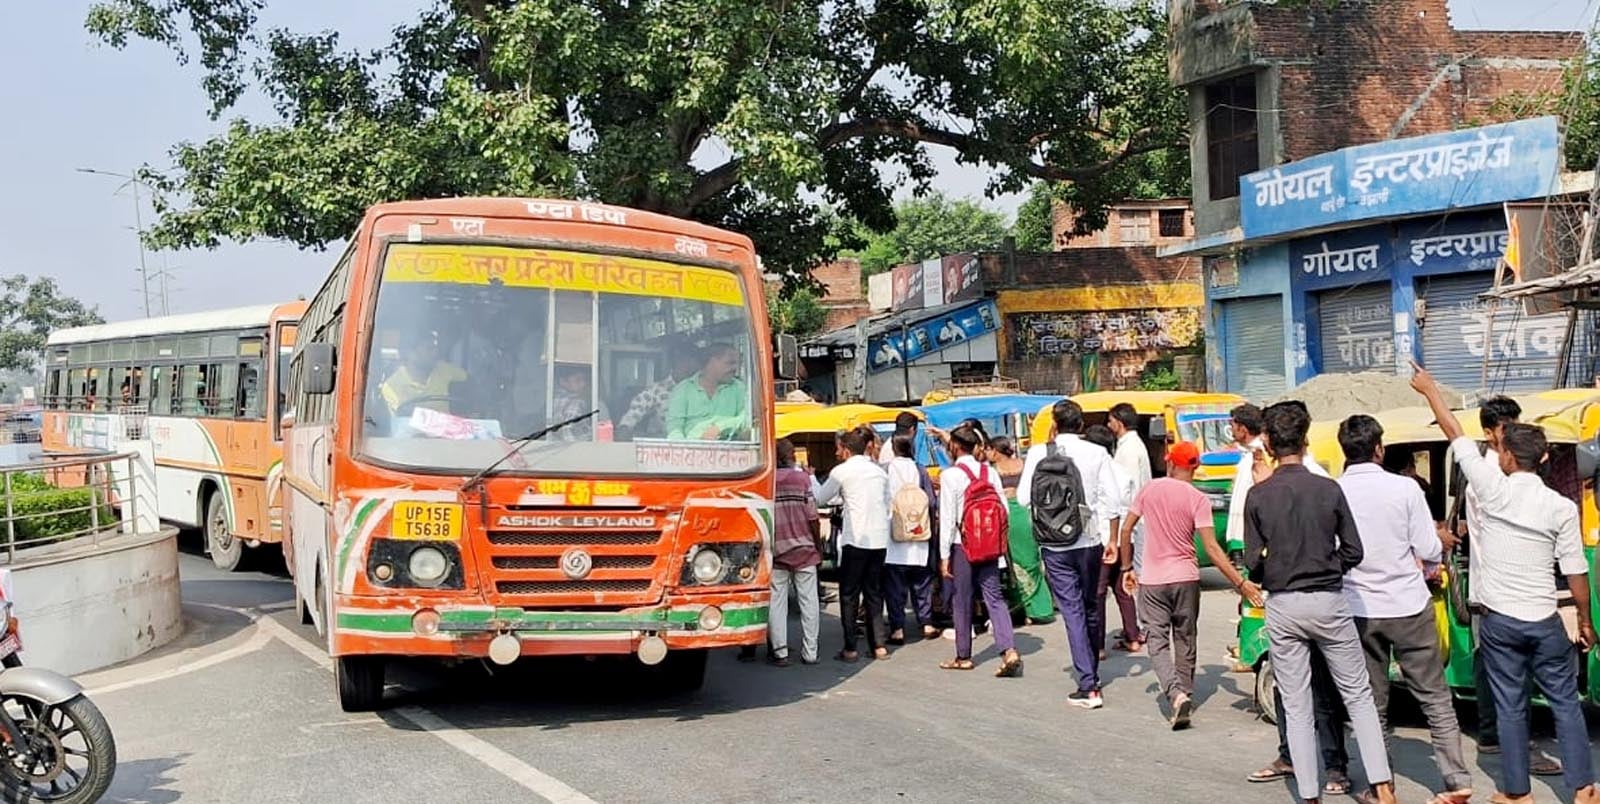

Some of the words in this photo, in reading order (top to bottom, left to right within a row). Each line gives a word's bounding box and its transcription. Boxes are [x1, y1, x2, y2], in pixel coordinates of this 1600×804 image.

[1255, 164, 1334, 207] गोयल
[523, 201, 574, 218] एटा
[450, 217, 486, 236] एटा
[1303, 242, 1380, 276] गोयल
[515, 252, 576, 283] प्रदेश
[581, 259, 684, 294] परिवहन
[405, 507, 424, 521] UP
[426, 507, 451, 522] 15E
[498, 515, 563, 527] ASHOK
[573, 516, 655, 527] LEYLAND
[405, 523, 451, 537] T5638
